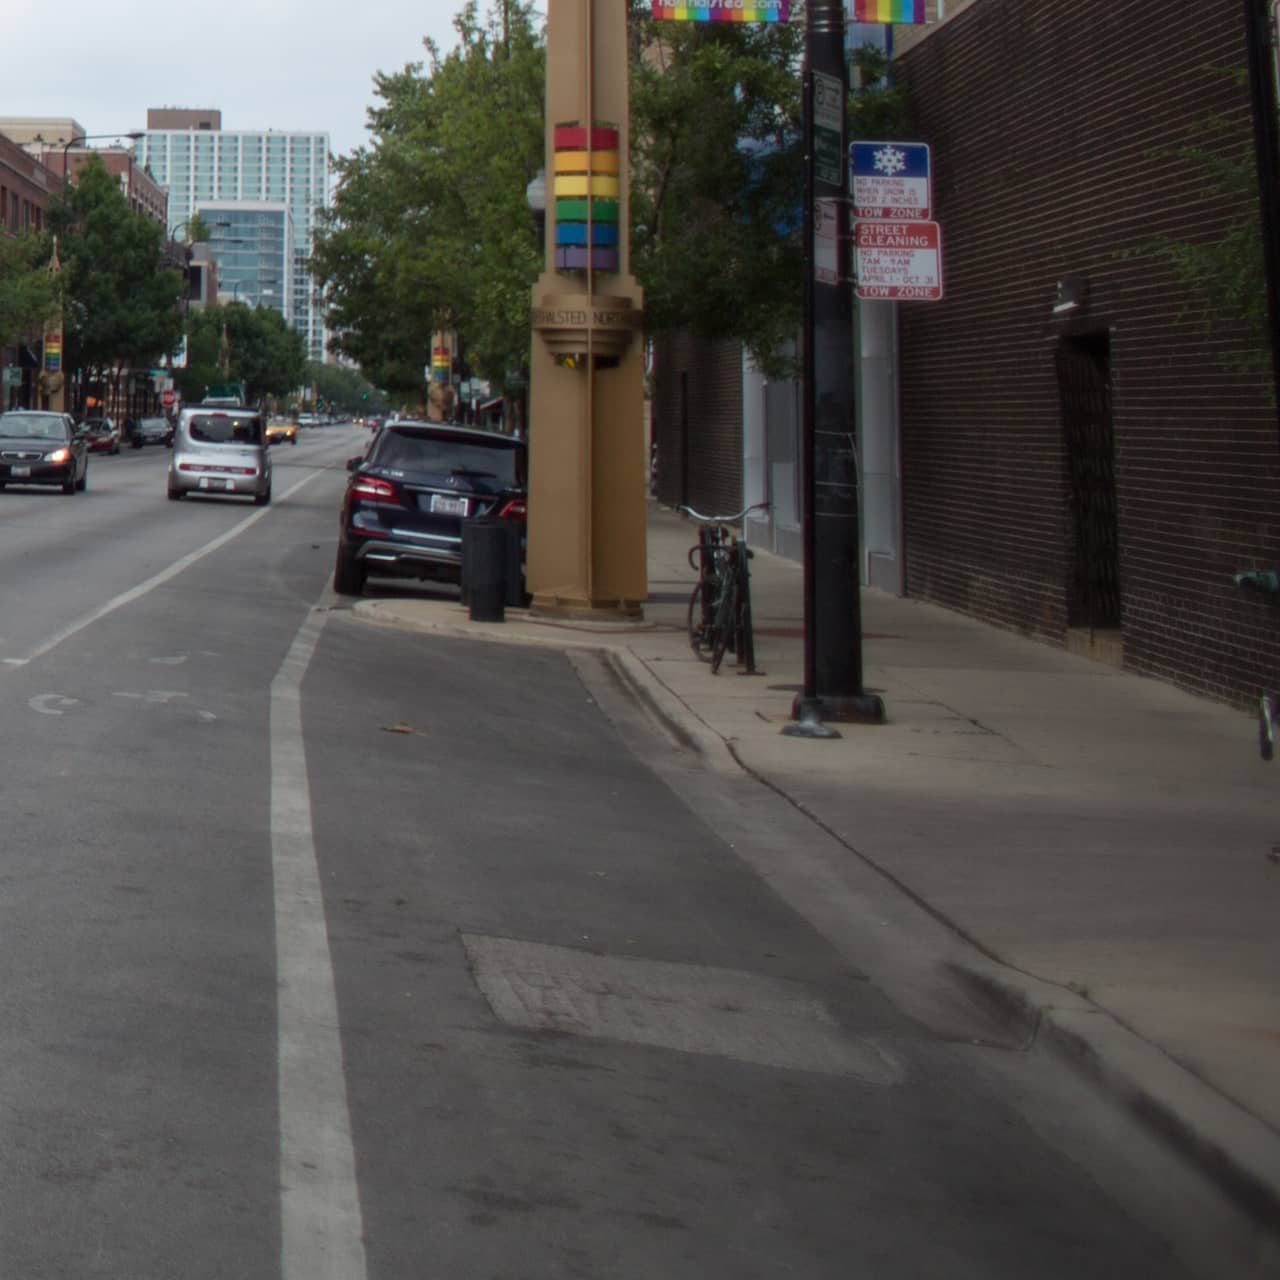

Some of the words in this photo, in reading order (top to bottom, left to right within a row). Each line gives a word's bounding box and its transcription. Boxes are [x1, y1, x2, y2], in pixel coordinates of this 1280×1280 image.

[856, 178, 867, 186] NO
[871, 178, 905, 187] PARKING
[858, 208, 883, 217] TOW
[890, 208, 923, 218] ZONE
[860, 224, 908, 235] STREET
[860, 235, 929, 246] CLEANING
[877, 250, 914, 258] PARKING
[861, 266, 909, 274] TUESDAYS
[862, 274, 886, 283] APRIL
[903, 276, 919, 284] OCT
[862, 286, 889, 296] TOW
[897, 287, 933, 297] ZONE
